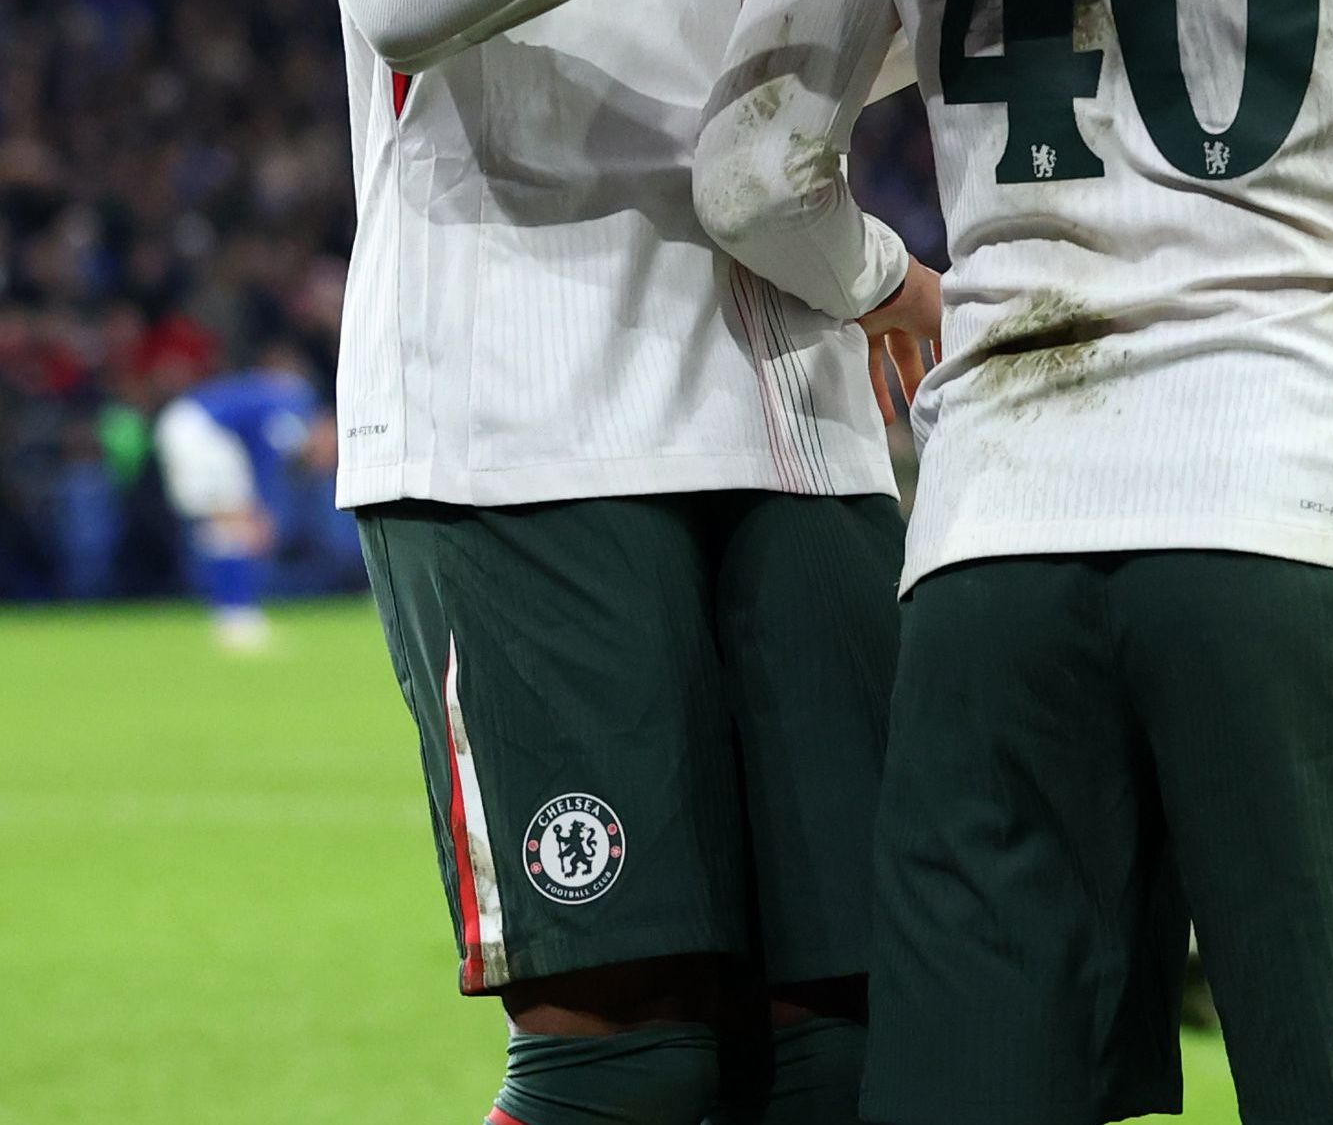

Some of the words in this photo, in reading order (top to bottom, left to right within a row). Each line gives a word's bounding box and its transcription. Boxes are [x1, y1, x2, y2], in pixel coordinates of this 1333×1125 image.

[538, 798, 600, 827] CHELSEA
[545, 883, 590, 899] FOOTBALL
[593, 870, 612, 891] CLUB
